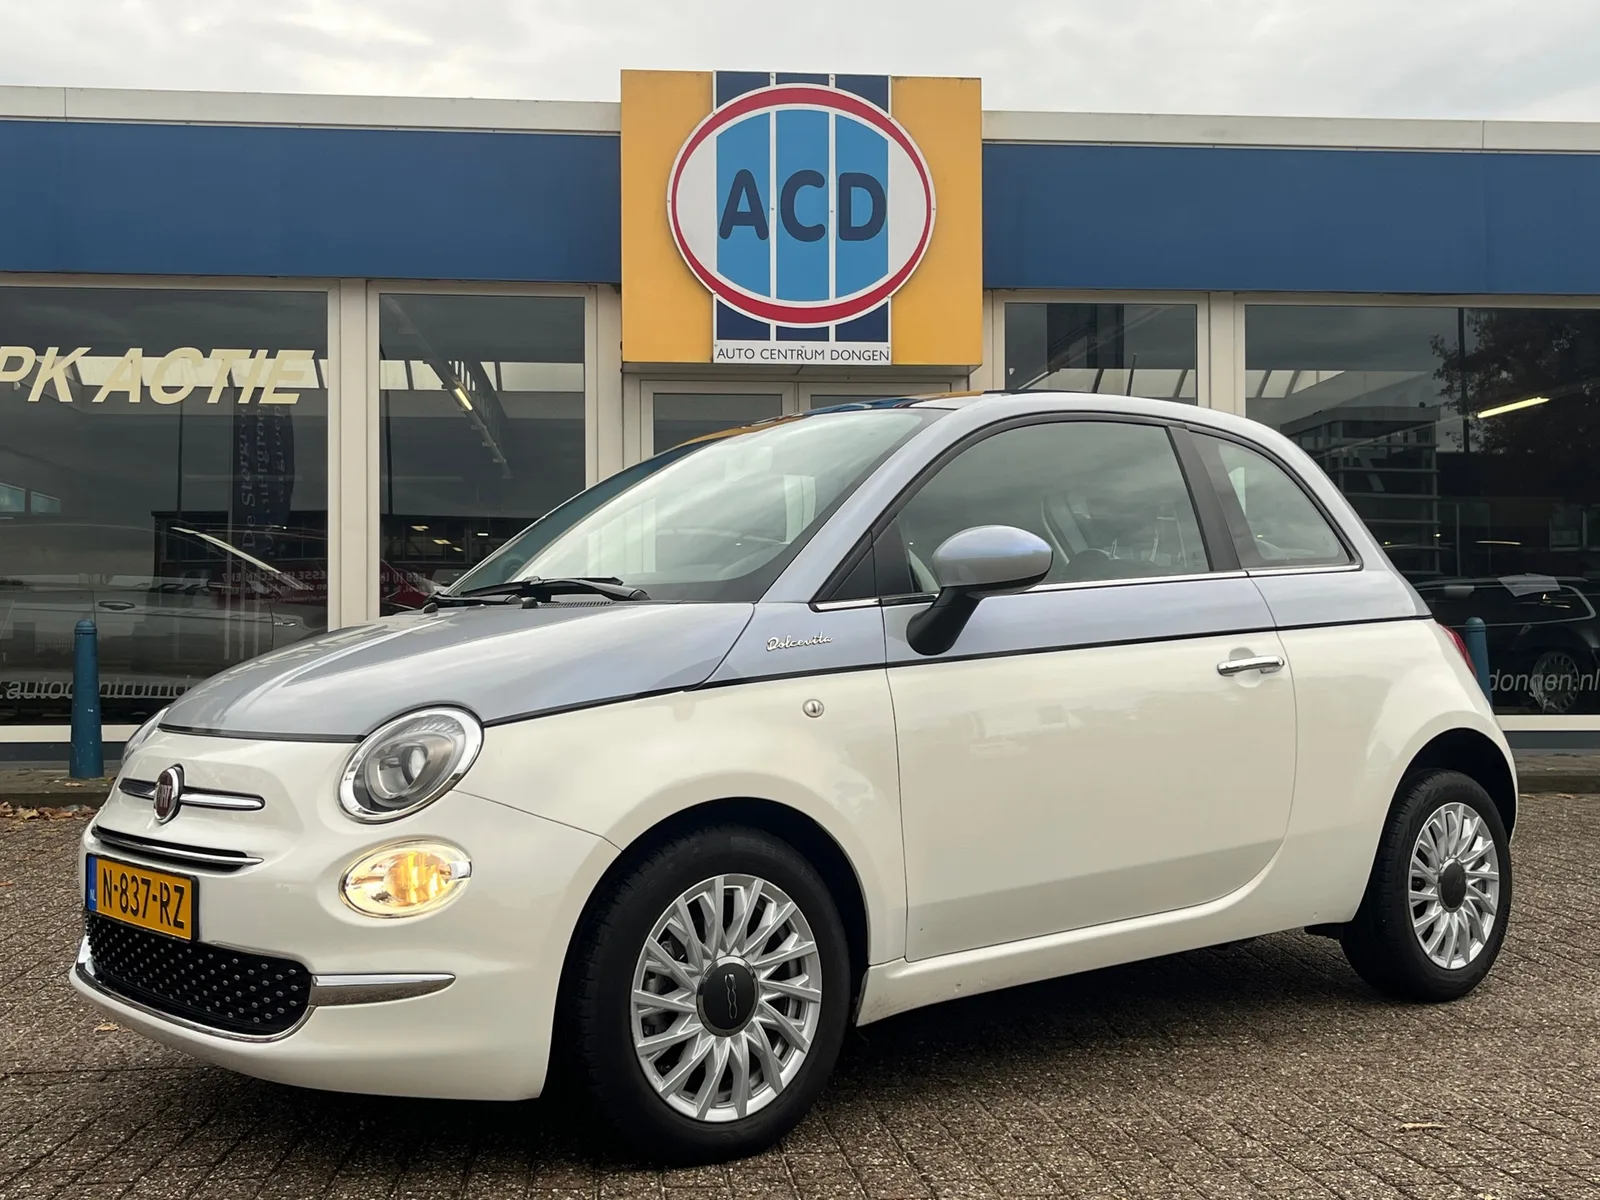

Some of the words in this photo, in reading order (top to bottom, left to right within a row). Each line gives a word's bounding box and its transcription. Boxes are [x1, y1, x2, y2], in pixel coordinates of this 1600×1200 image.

[719, 169, 887, 242] ACD
[92, 347, 316, 405] ACTIE
[716, 347, 755, 361] AUTO
[760, 348, 825, 361] CENTRUM
[830, 349, 890, 362] DONGEN
[766, 631, 834, 651] Dolcevita
[103, 867, 185, 929] N-837-RZ
